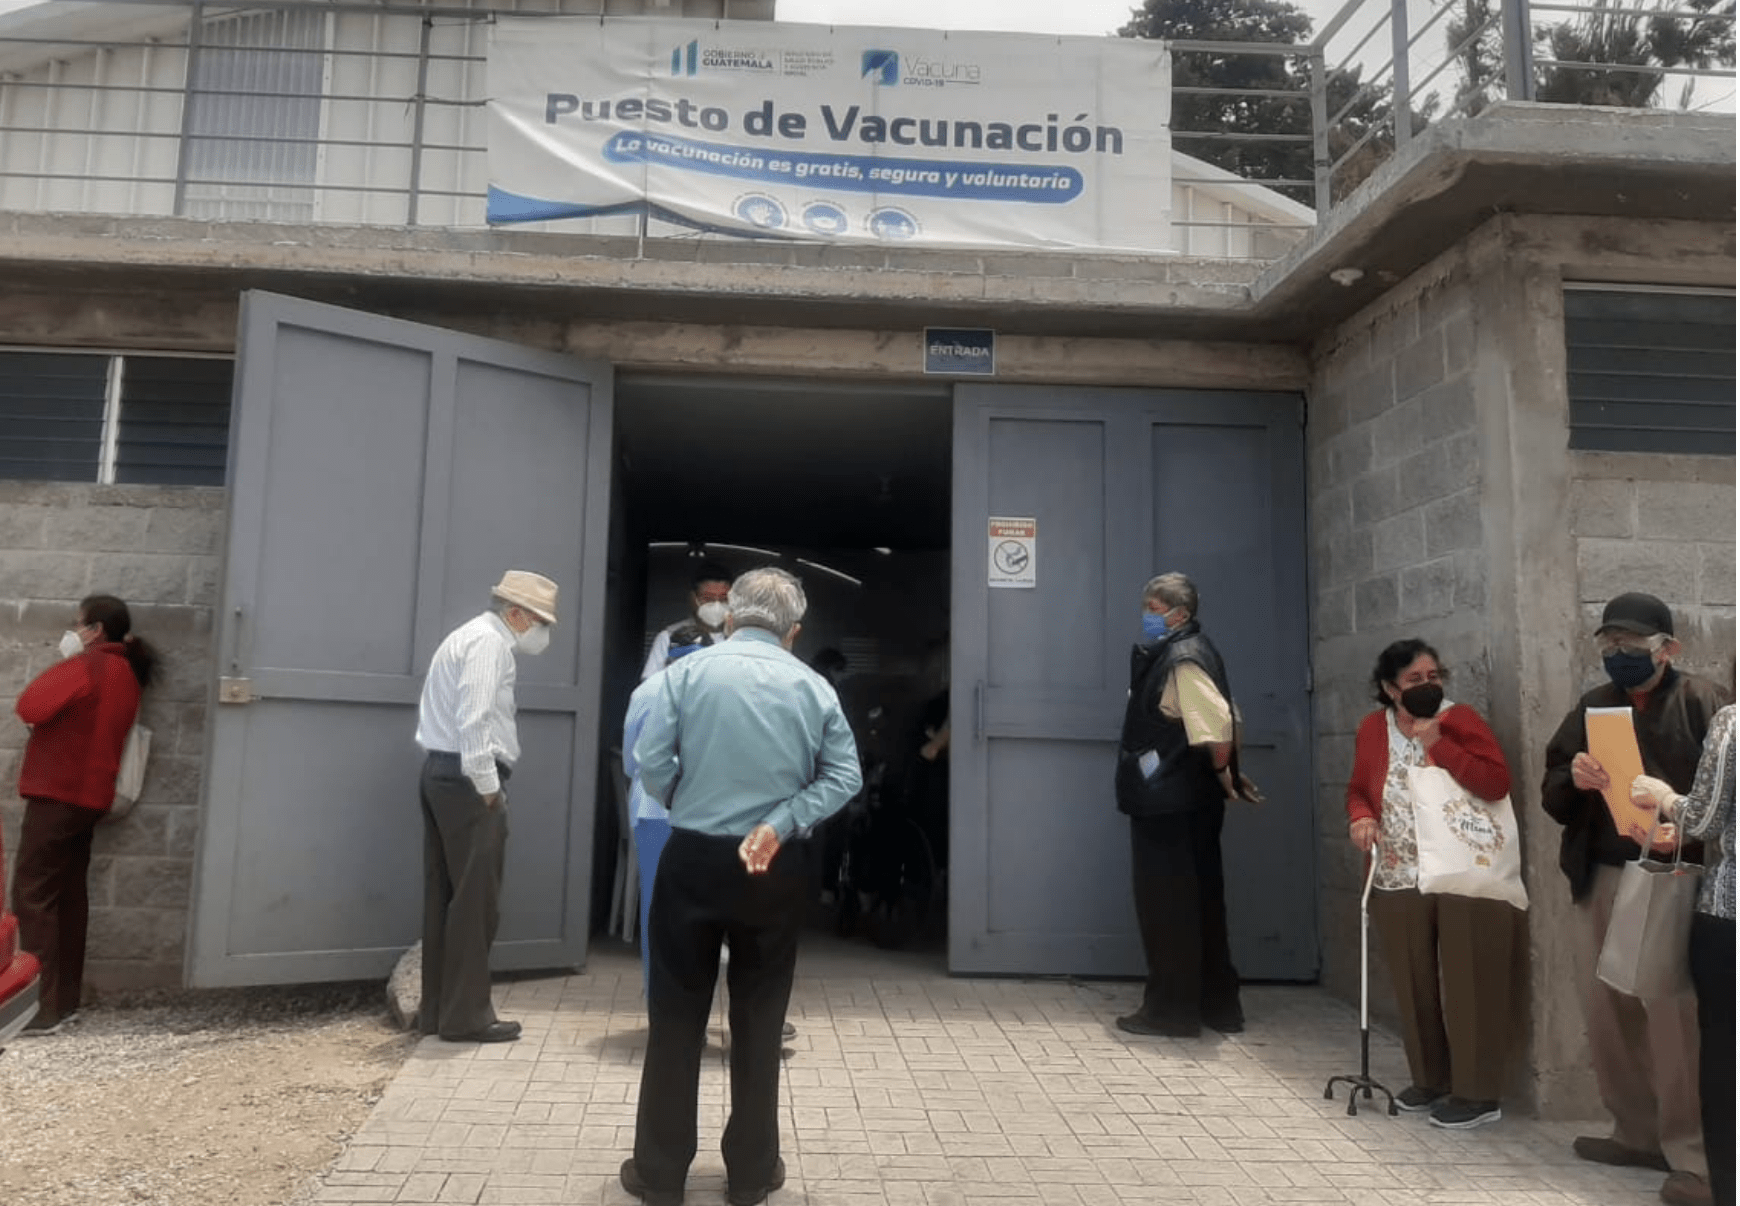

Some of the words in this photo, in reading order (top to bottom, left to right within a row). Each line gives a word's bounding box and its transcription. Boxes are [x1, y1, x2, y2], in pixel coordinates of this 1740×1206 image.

[703, 49, 755, 59] GOBIERNO
[702, 58, 773, 69] GUATEMALA
[905, 56, 980, 79] Vacuna
[903, 77, 945, 87] COVID-19
[545, 93, 729, 131] Puesto
[743, 100, 806, 138] de
[820, 105, 1123, 154] Vacunación
[615, 138, 640, 151] La
[646, 140, 764, 170] vacunación
[769, 159, 792, 172] es
[795, 160, 863, 181] gratis,
[869, 166, 941, 184] segura
[945, 171, 959, 188] y
[962, 169, 1072, 190] voluntaria
[930, 345, 990, 357] ENTRADA
